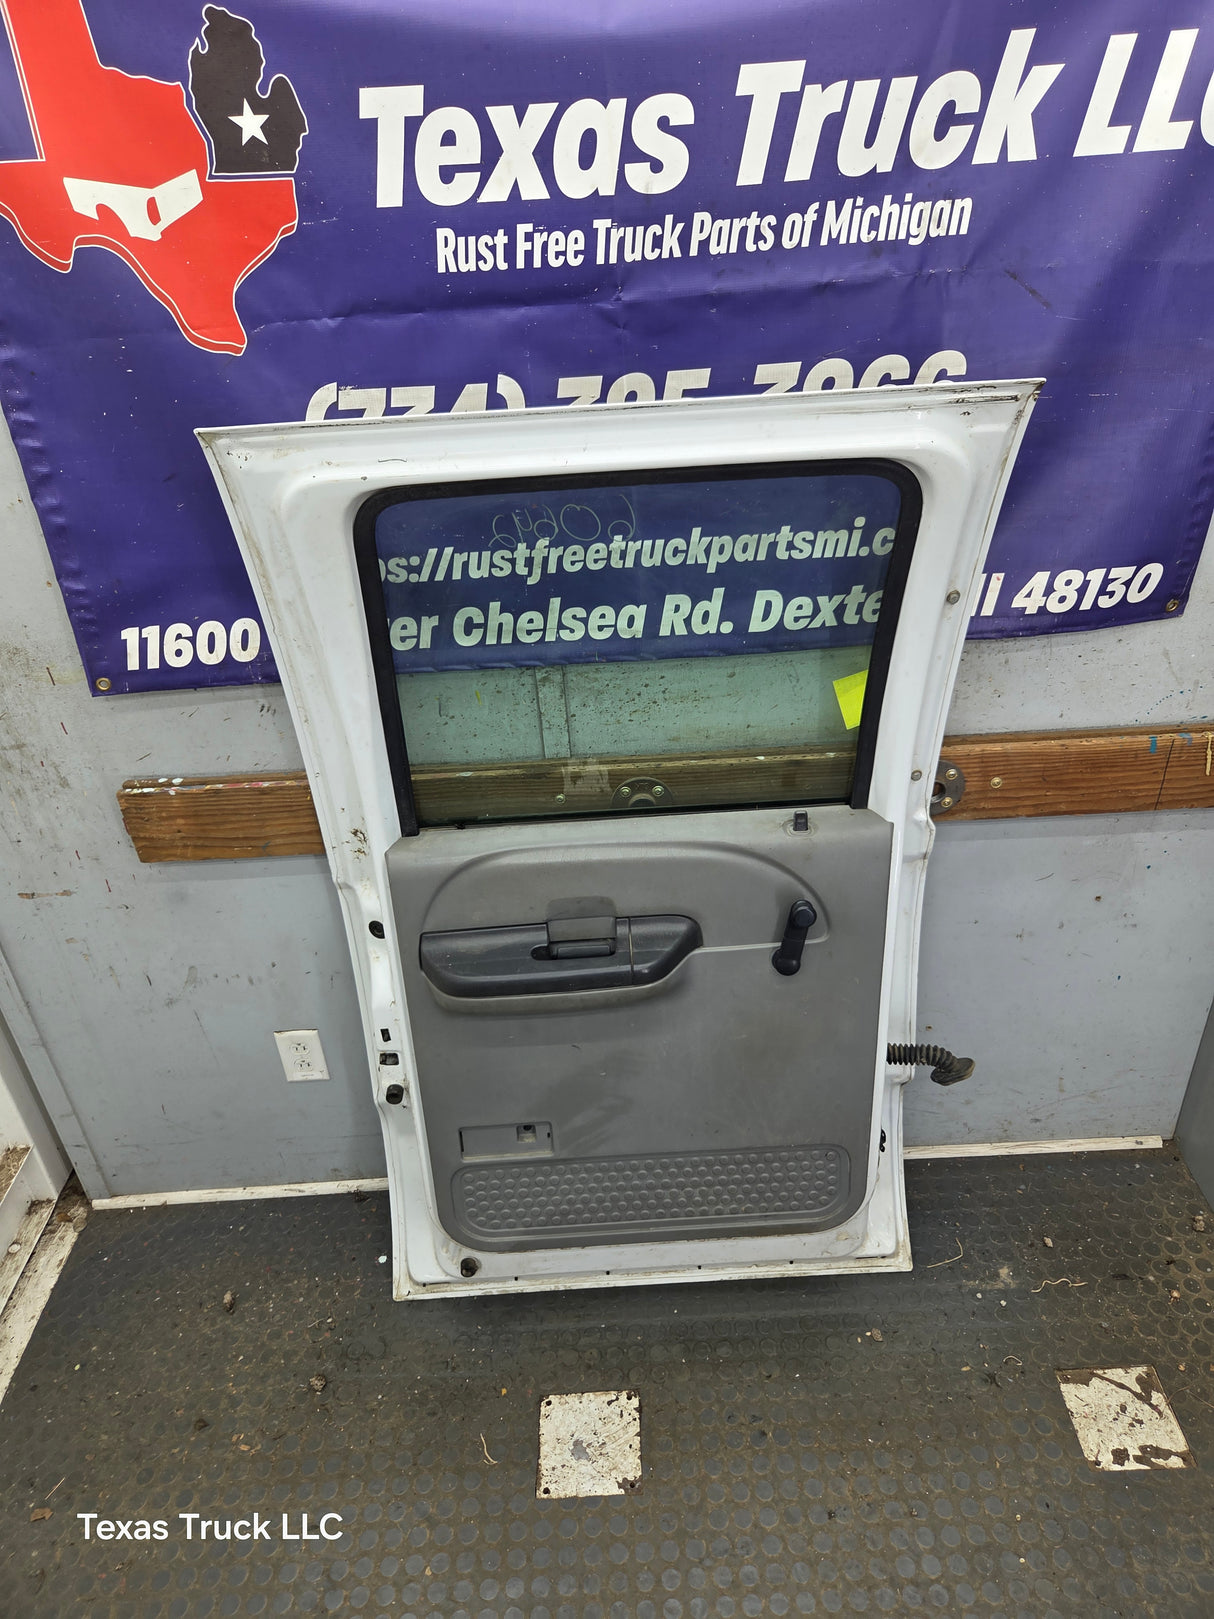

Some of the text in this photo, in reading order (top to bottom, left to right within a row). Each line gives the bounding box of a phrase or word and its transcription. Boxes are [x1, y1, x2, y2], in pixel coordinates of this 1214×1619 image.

[359, 28, 1214, 208] Texas Truck LL
[436, 193, 973, 273] Rust Free Truck Parts of Michigan
[121, 618, 261, 671] 11600
[387, 615, 439, 651] er
[453, 597, 647, 647] Chelsea
[659, 587, 734, 637] Rd.
[1011, 562, 1164, 615] 48130
